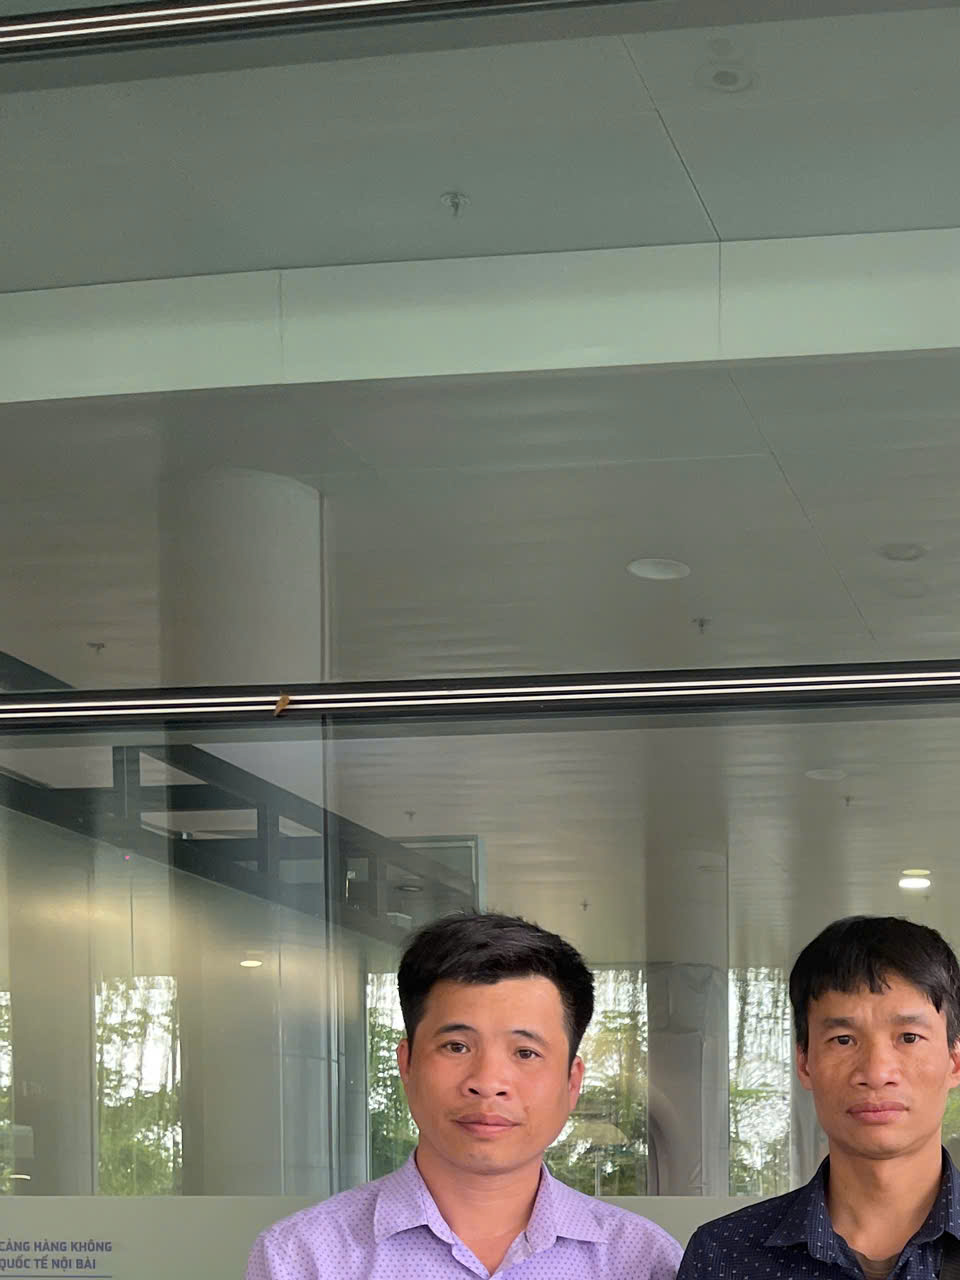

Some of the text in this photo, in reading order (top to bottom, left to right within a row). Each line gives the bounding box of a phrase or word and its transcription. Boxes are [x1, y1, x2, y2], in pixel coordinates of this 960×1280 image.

[34, 1238, 67, 1252] HÀNG
[71, 1239, 112, 1252] KHÔNG
[0, 1254, 96, 1272] QUỐC TẾ NỘI BÀI
